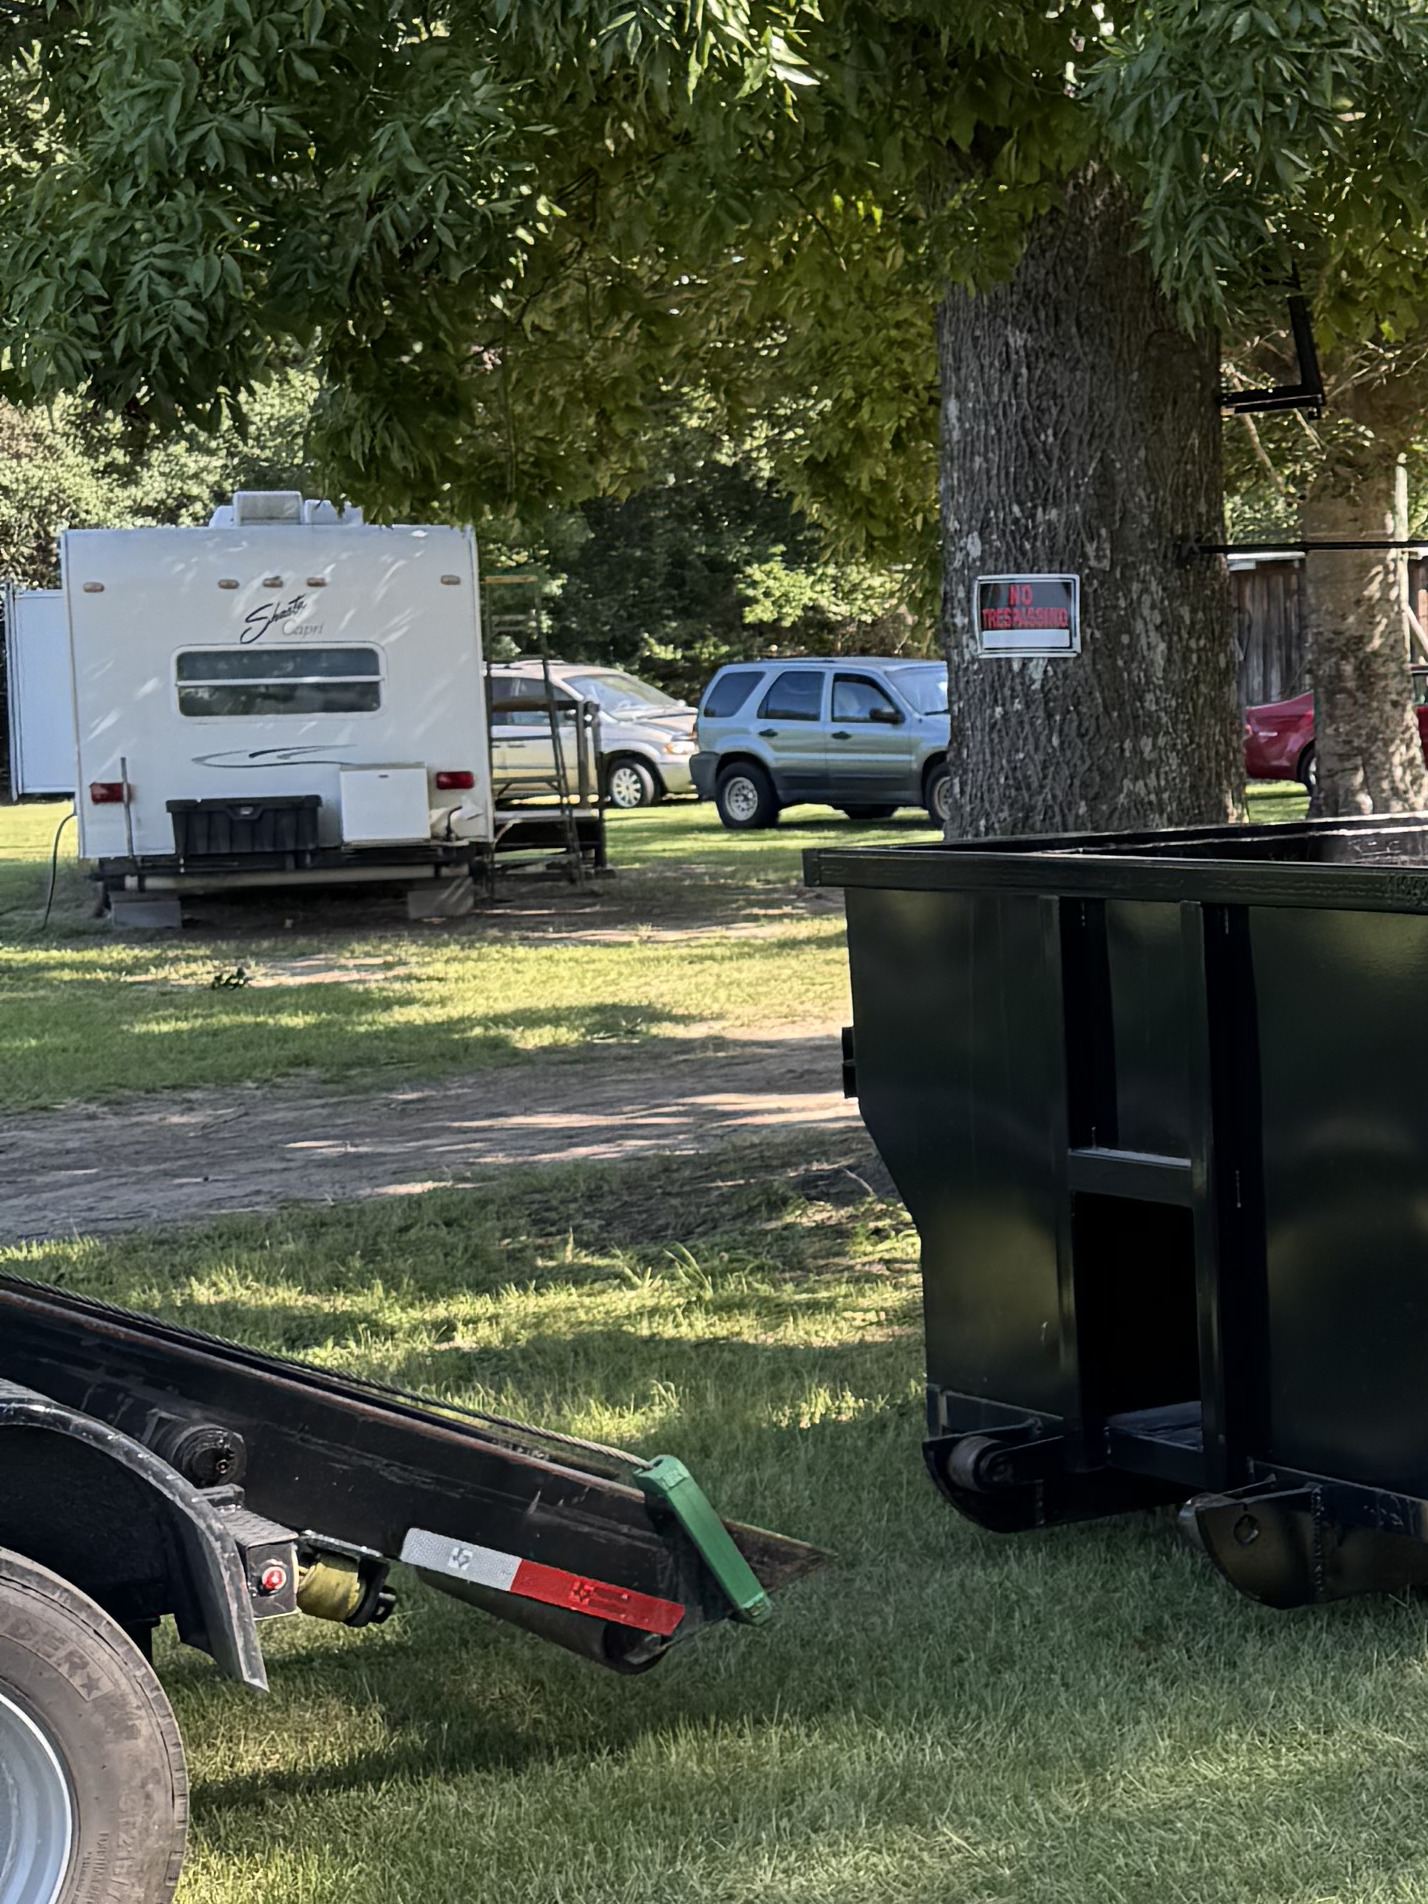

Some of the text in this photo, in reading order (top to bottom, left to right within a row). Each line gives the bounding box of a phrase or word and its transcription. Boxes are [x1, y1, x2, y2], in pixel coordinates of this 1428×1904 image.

[1008, 583, 1033, 606] NO
[239, 593, 308, 645] Shasta
[282, 618, 324, 638] Capri
[982, 607, 1068, 629] TRESPASSING
